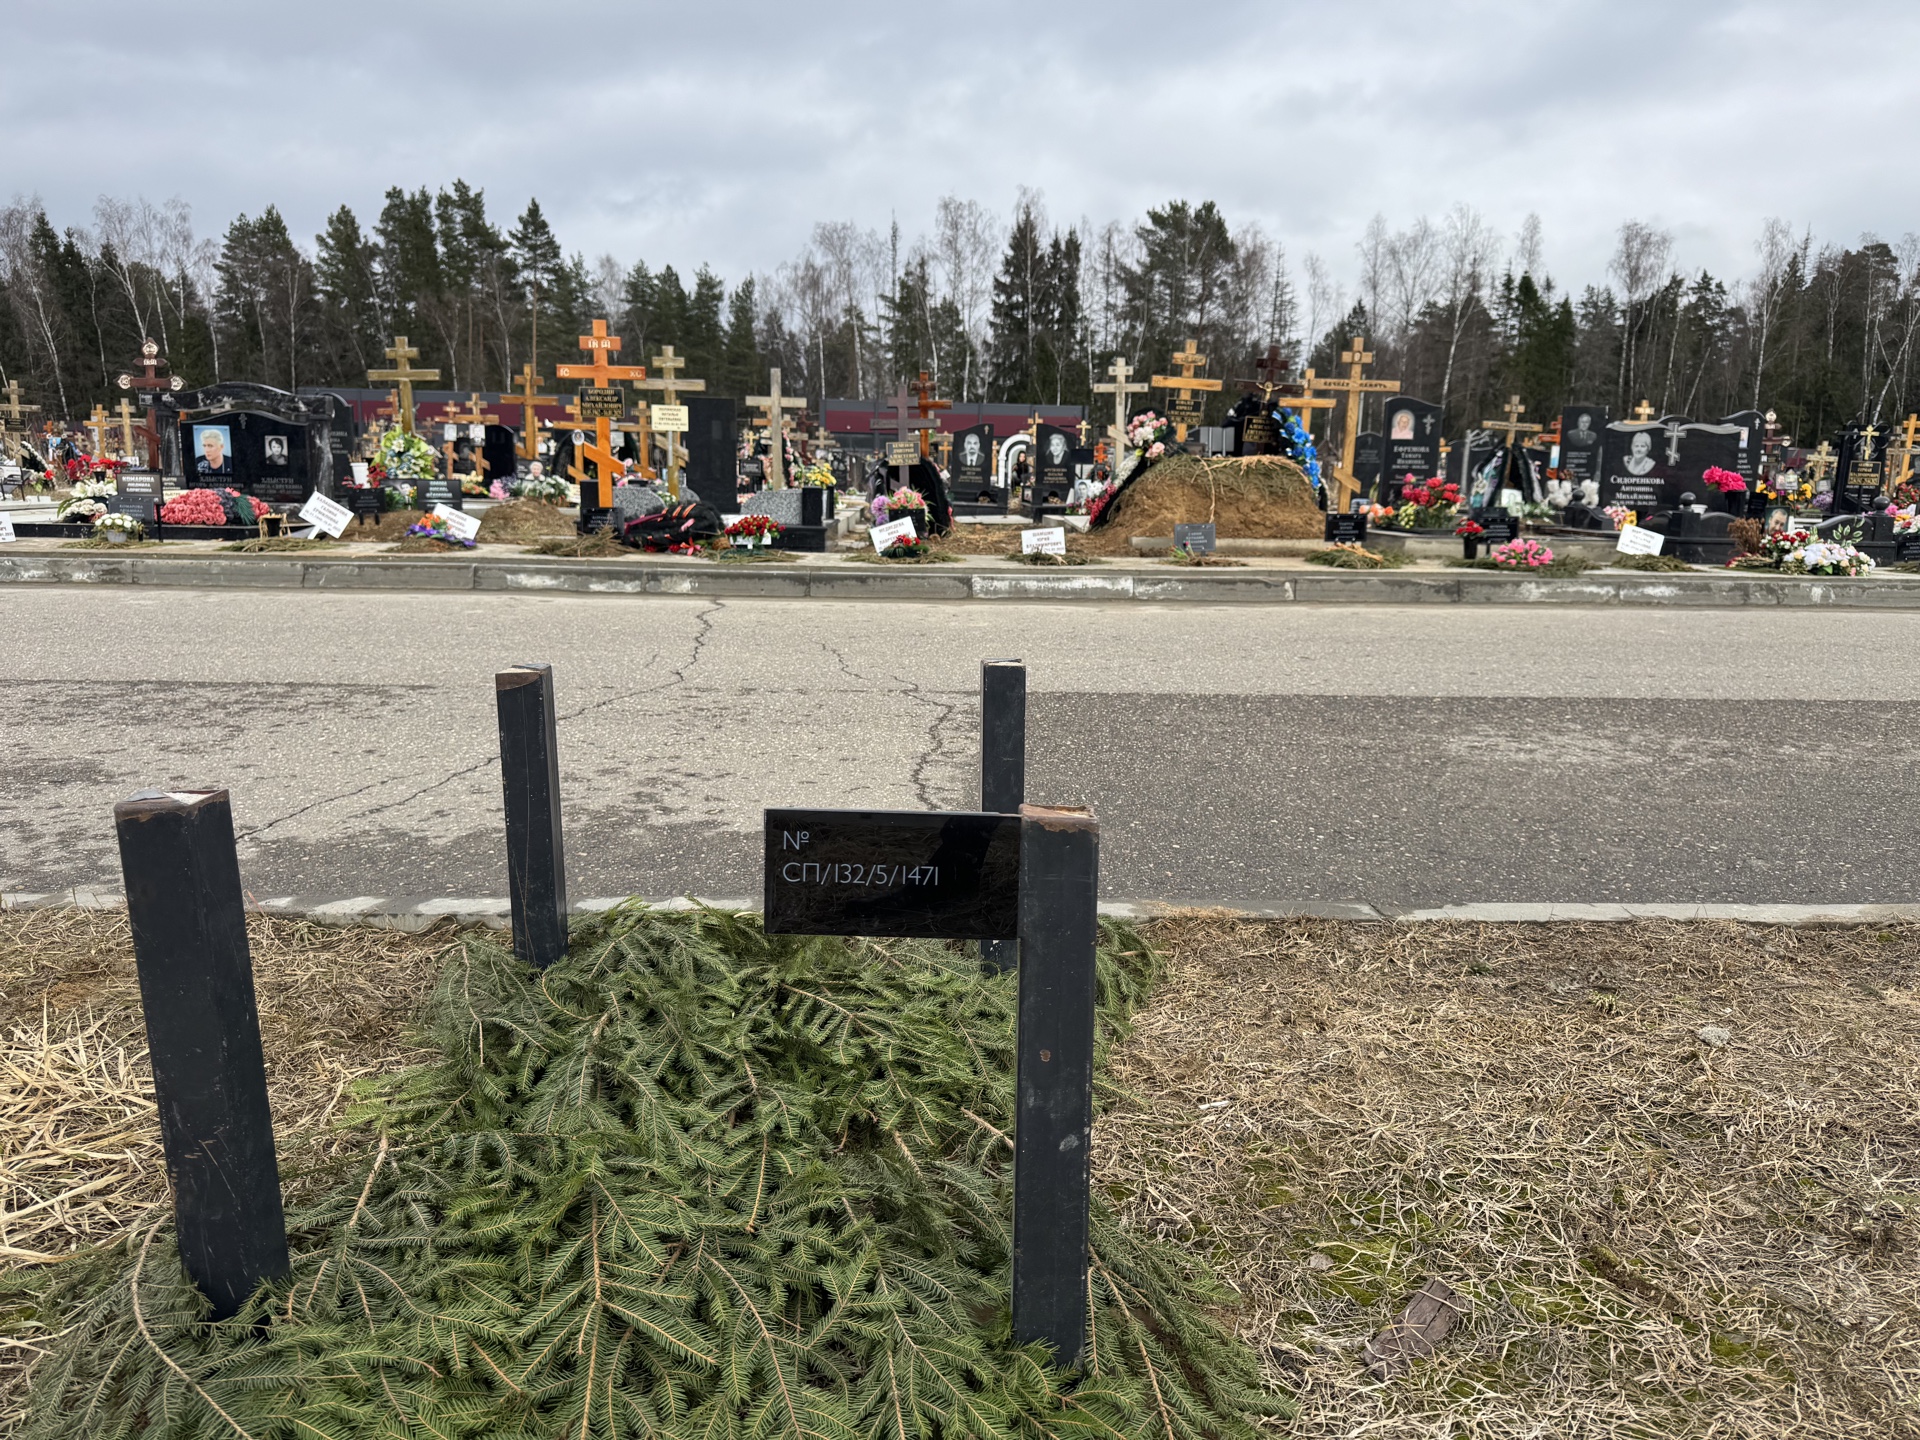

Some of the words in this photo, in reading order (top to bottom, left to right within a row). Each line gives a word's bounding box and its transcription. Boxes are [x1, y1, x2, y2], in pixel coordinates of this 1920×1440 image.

[1610, 475, 1665, 484] СИДОРЕНКОВА
[879, 522, 904, 533] МЕДВЕДЕВА
[783, 831, 809, 850] №
[783, 862, 938, 886] СП/132/5/1471
